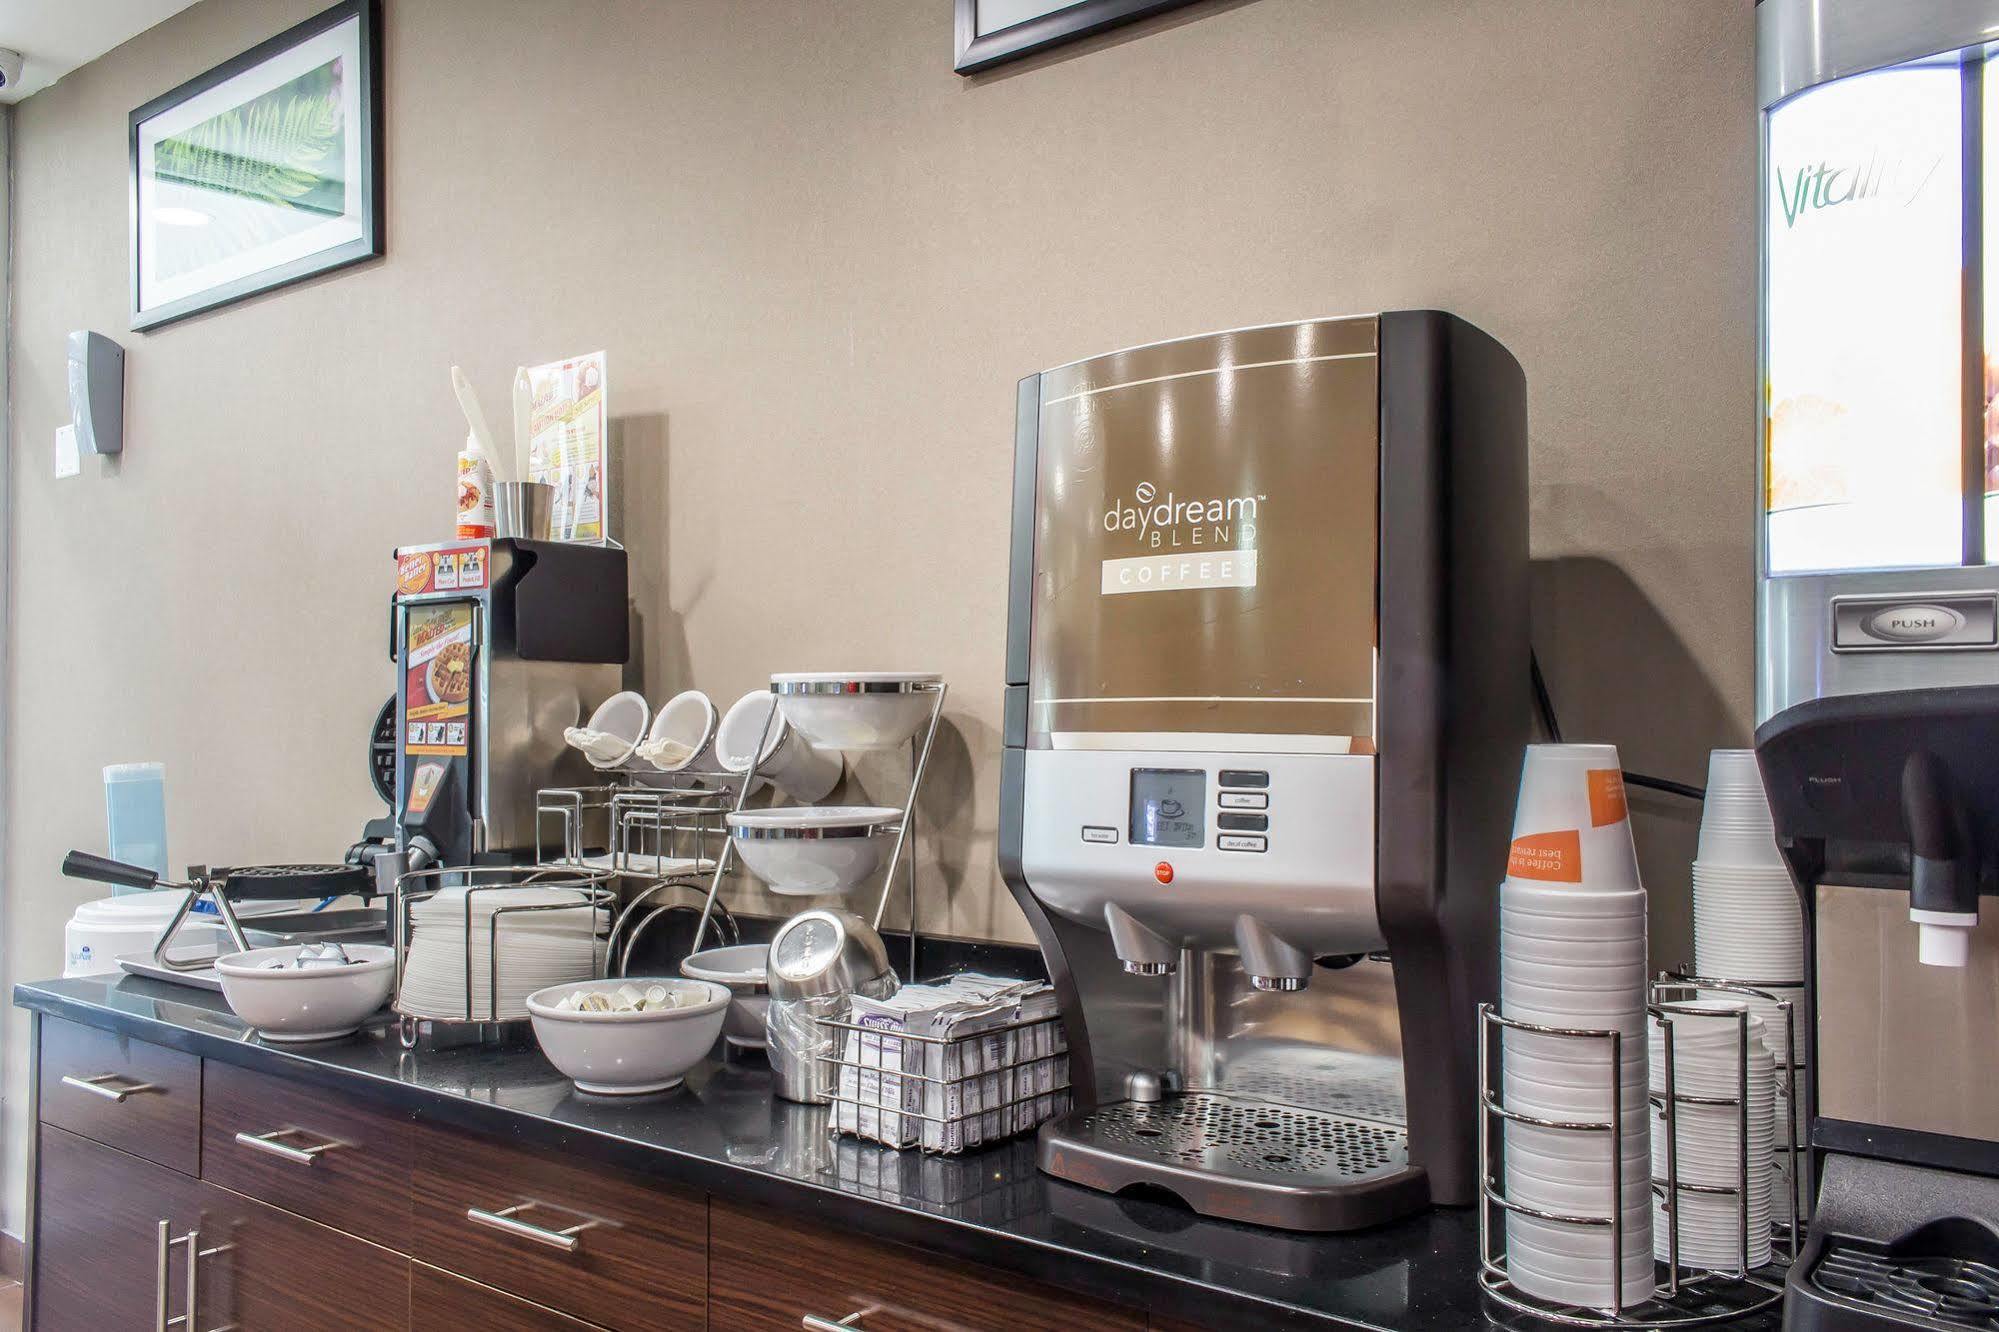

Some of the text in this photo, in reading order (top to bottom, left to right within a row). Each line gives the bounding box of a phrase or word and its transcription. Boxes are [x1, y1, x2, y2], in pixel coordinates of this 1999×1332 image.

[1776, 152, 1945, 229] Vital
[1151, 523, 1257, 548] BLEND
[1119, 560, 1233, 585] COFFEE
[1891, 618, 1936, 629] PUSH
[1538, 847, 1561, 859] best
[1526, 859, 1561, 870] Coffee
